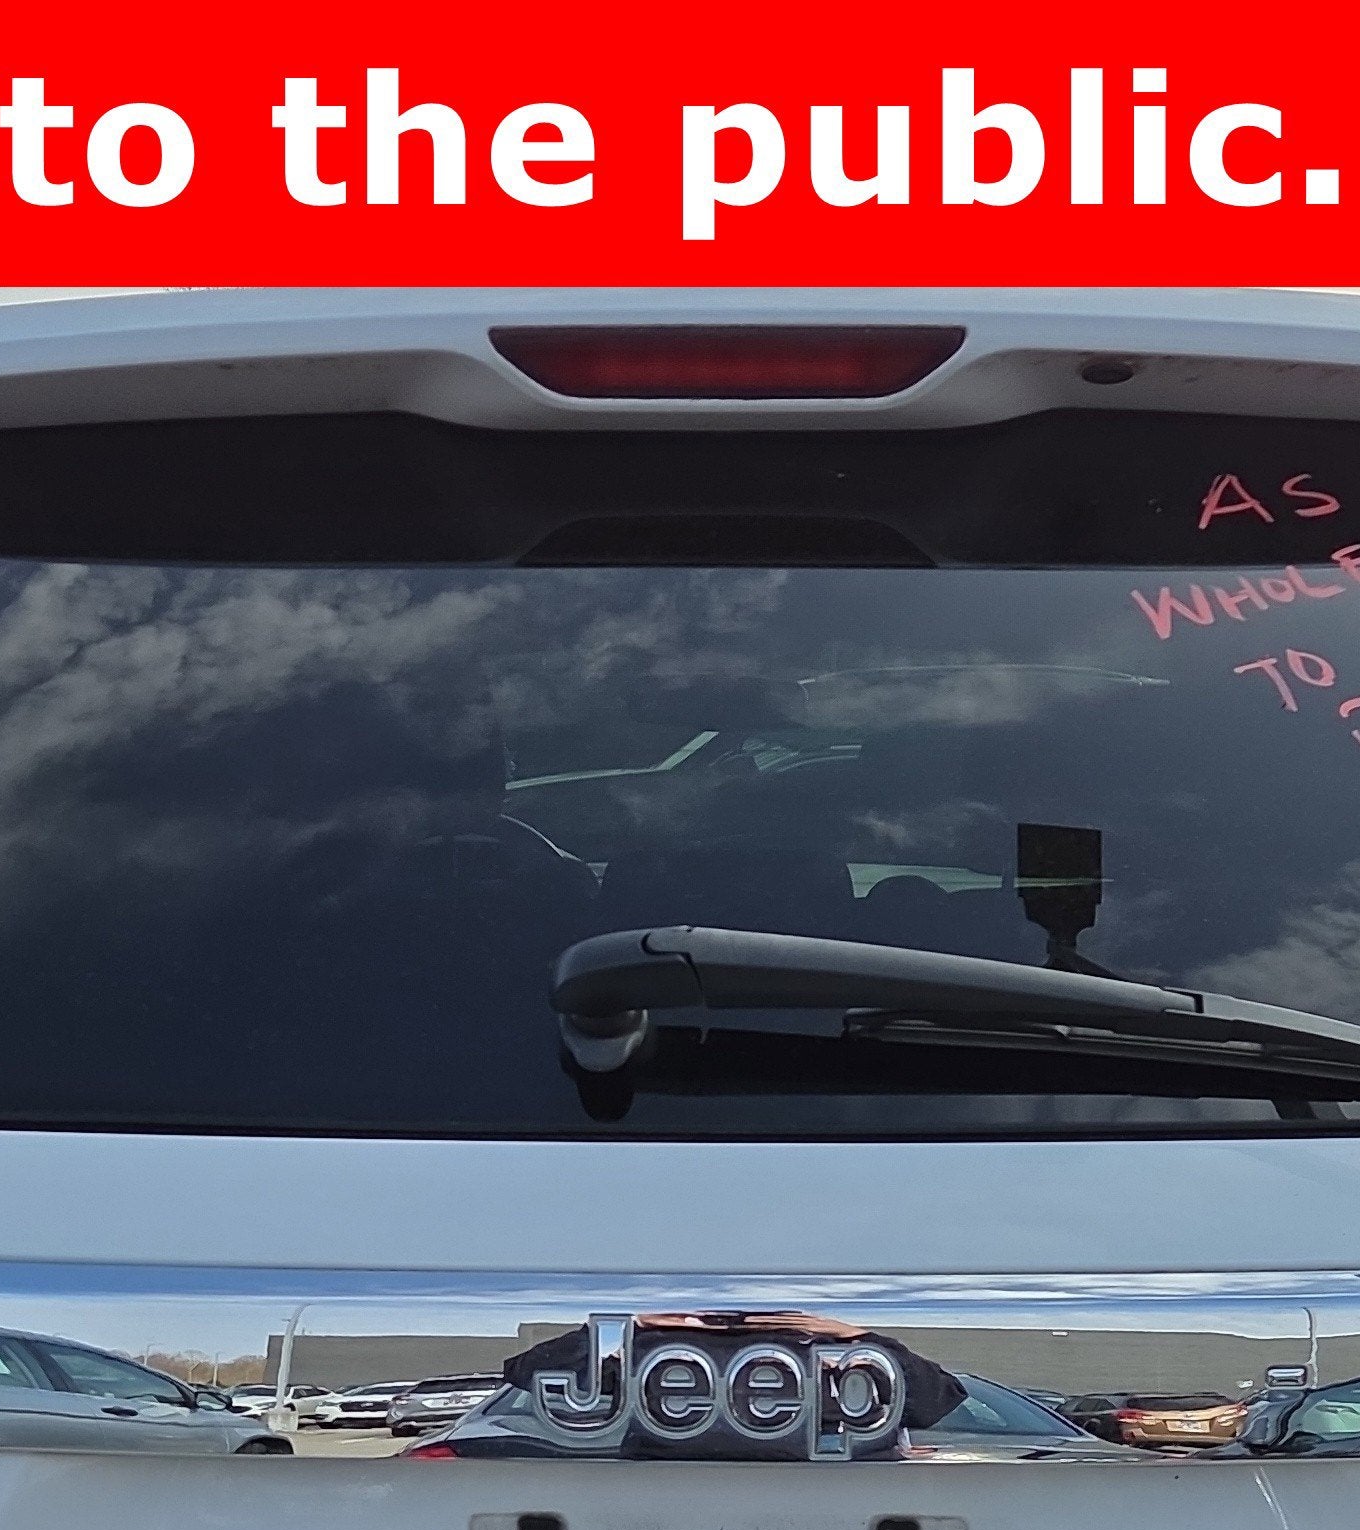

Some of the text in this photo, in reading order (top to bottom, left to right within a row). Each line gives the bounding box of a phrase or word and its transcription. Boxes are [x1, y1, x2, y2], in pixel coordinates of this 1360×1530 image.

[1196, 473, 1341, 531] AS
[1234, 648, 1336, 712] TO
[533, 1312, 907, 1462] Jeep
